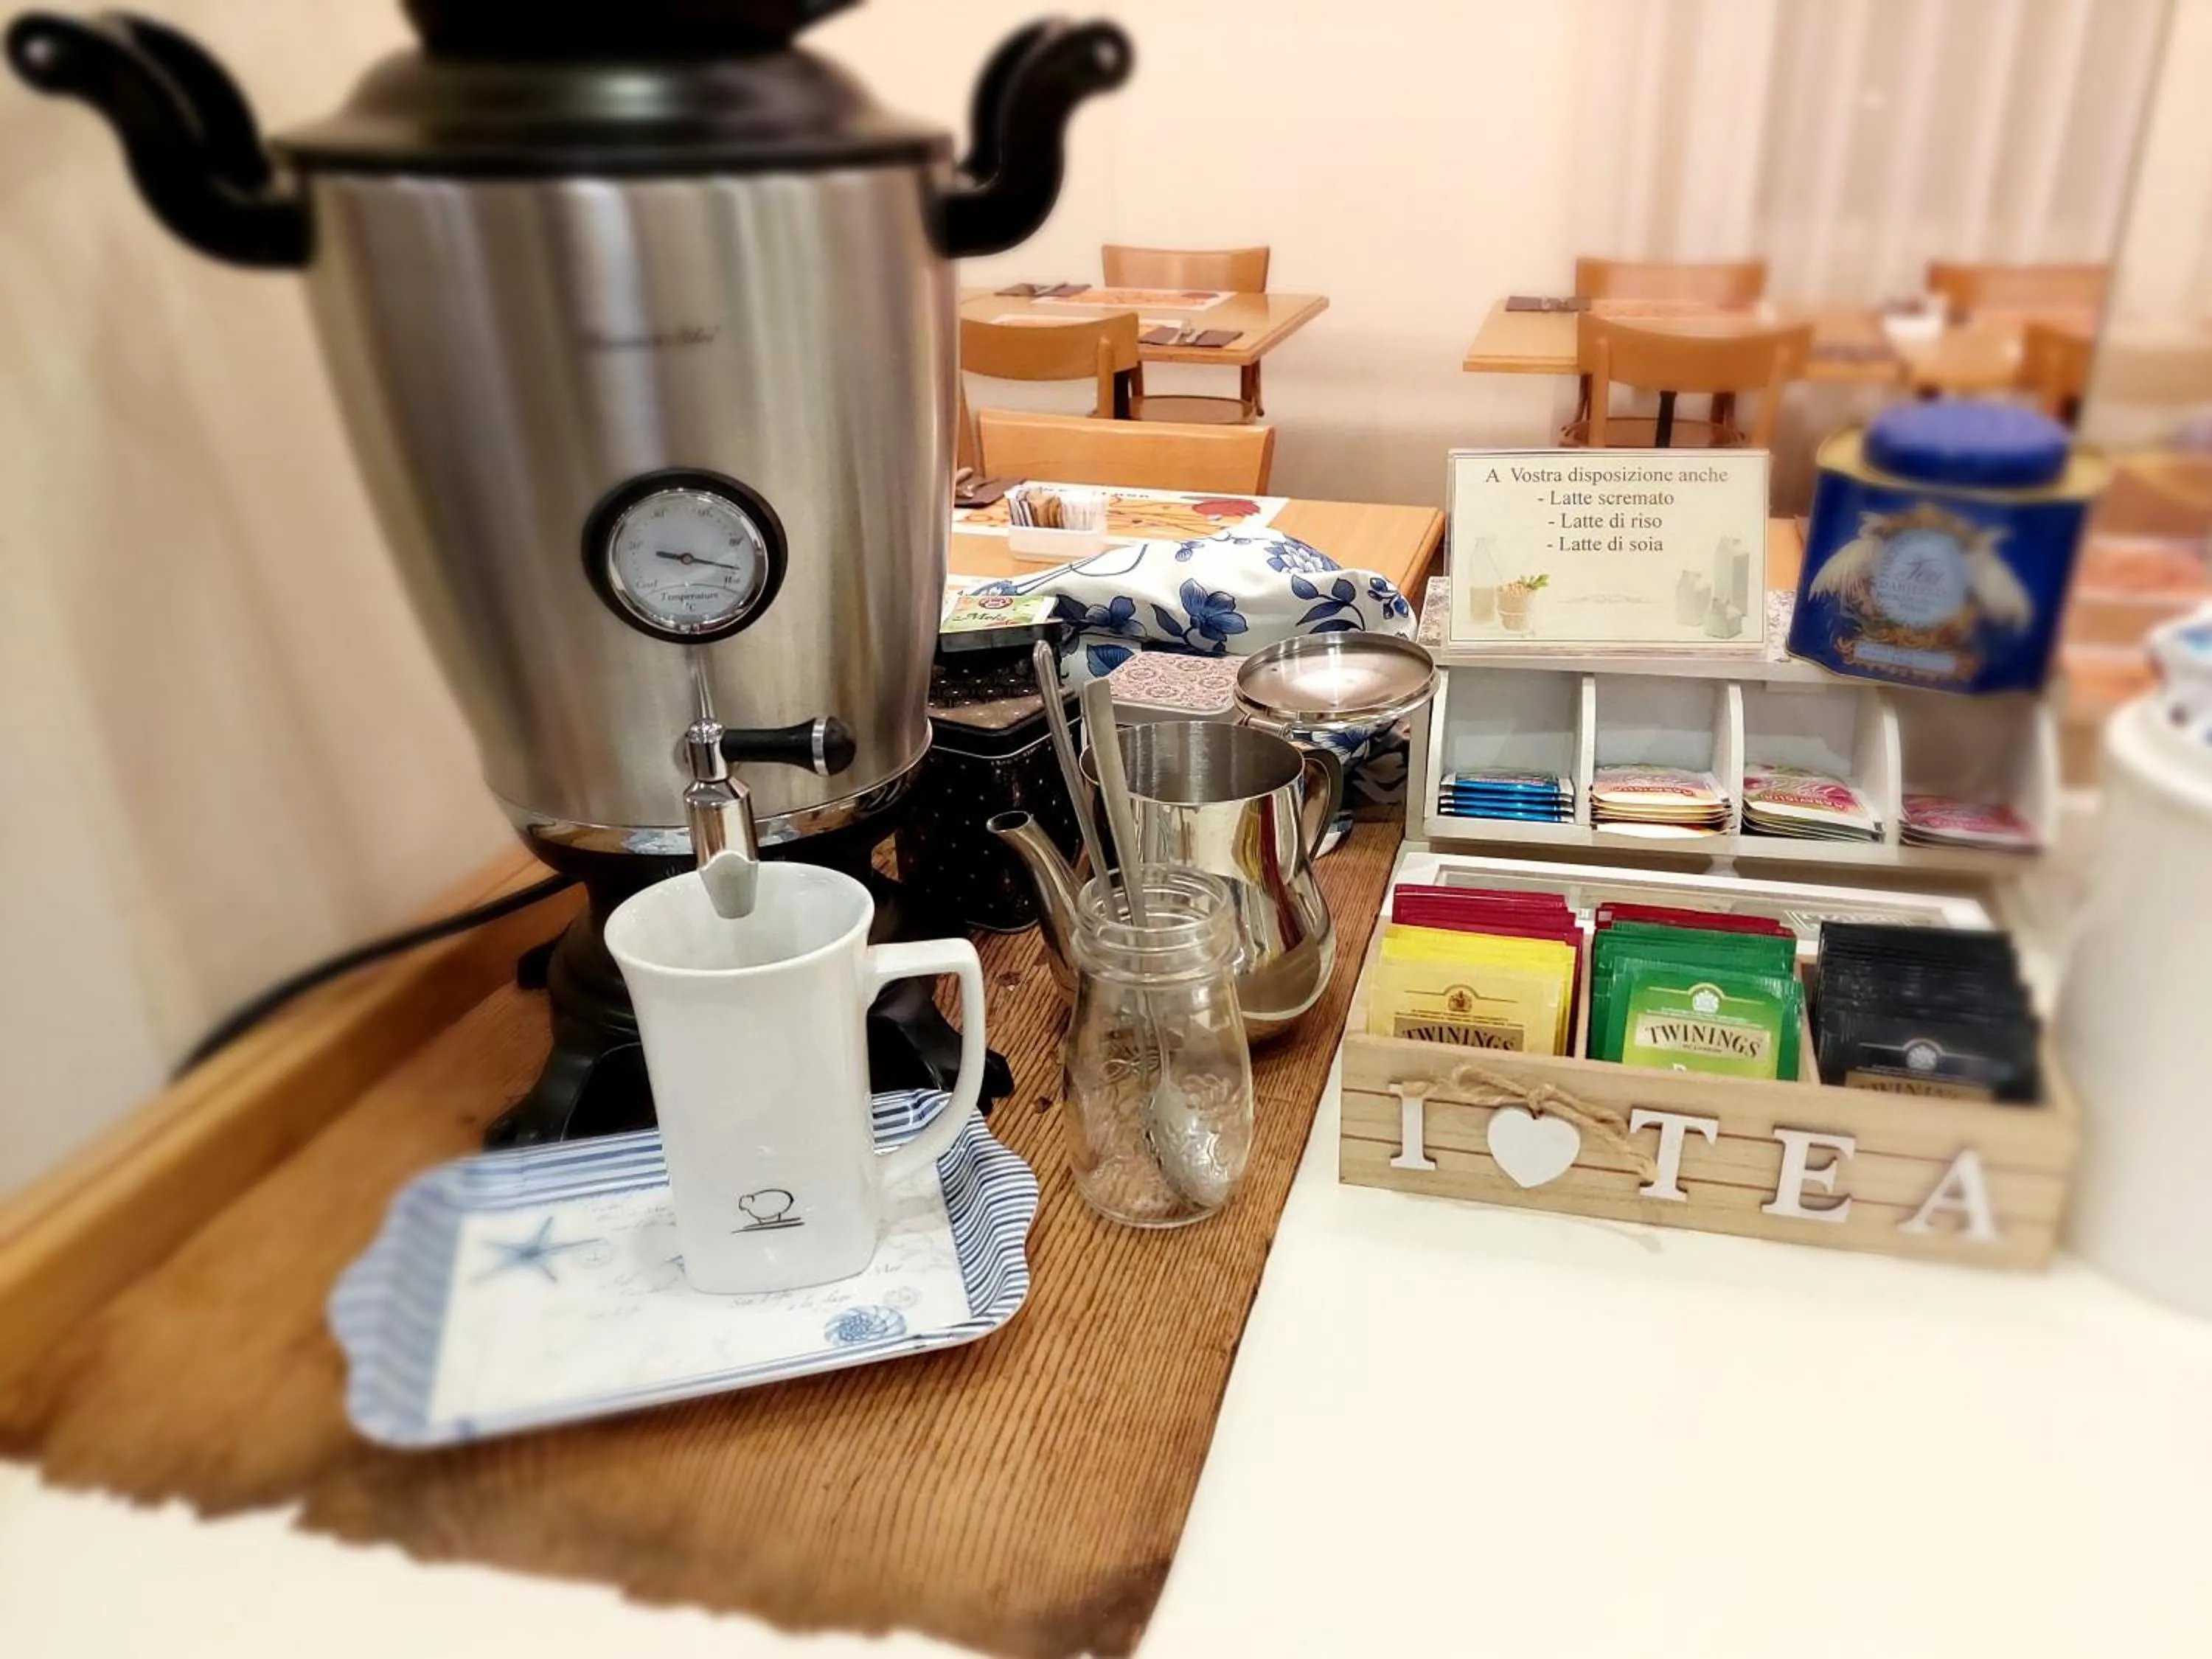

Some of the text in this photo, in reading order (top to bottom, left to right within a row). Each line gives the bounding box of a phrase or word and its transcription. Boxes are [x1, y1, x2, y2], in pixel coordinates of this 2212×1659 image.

[1486, 466, 1729, 486] A Vostra disposizione anche
[1550, 490, 1593, 505] Latte
[1598, 492, 1674, 505] scremato
[1561, 512, 1604, 529] Latte
[1609, 512, 1625, 529] di
[1631, 512, 1663, 529] riso
[1559, 536, 1602, 552] Latte
[1607, 536, 1623, 552] di
[1629, 536, 1663, 552] soia
[661, 591, 719, 602] Temperature
[1645, 1024, 1761, 1058] TWININGS
[1389, 1083, 2000, 1243] I TEA
